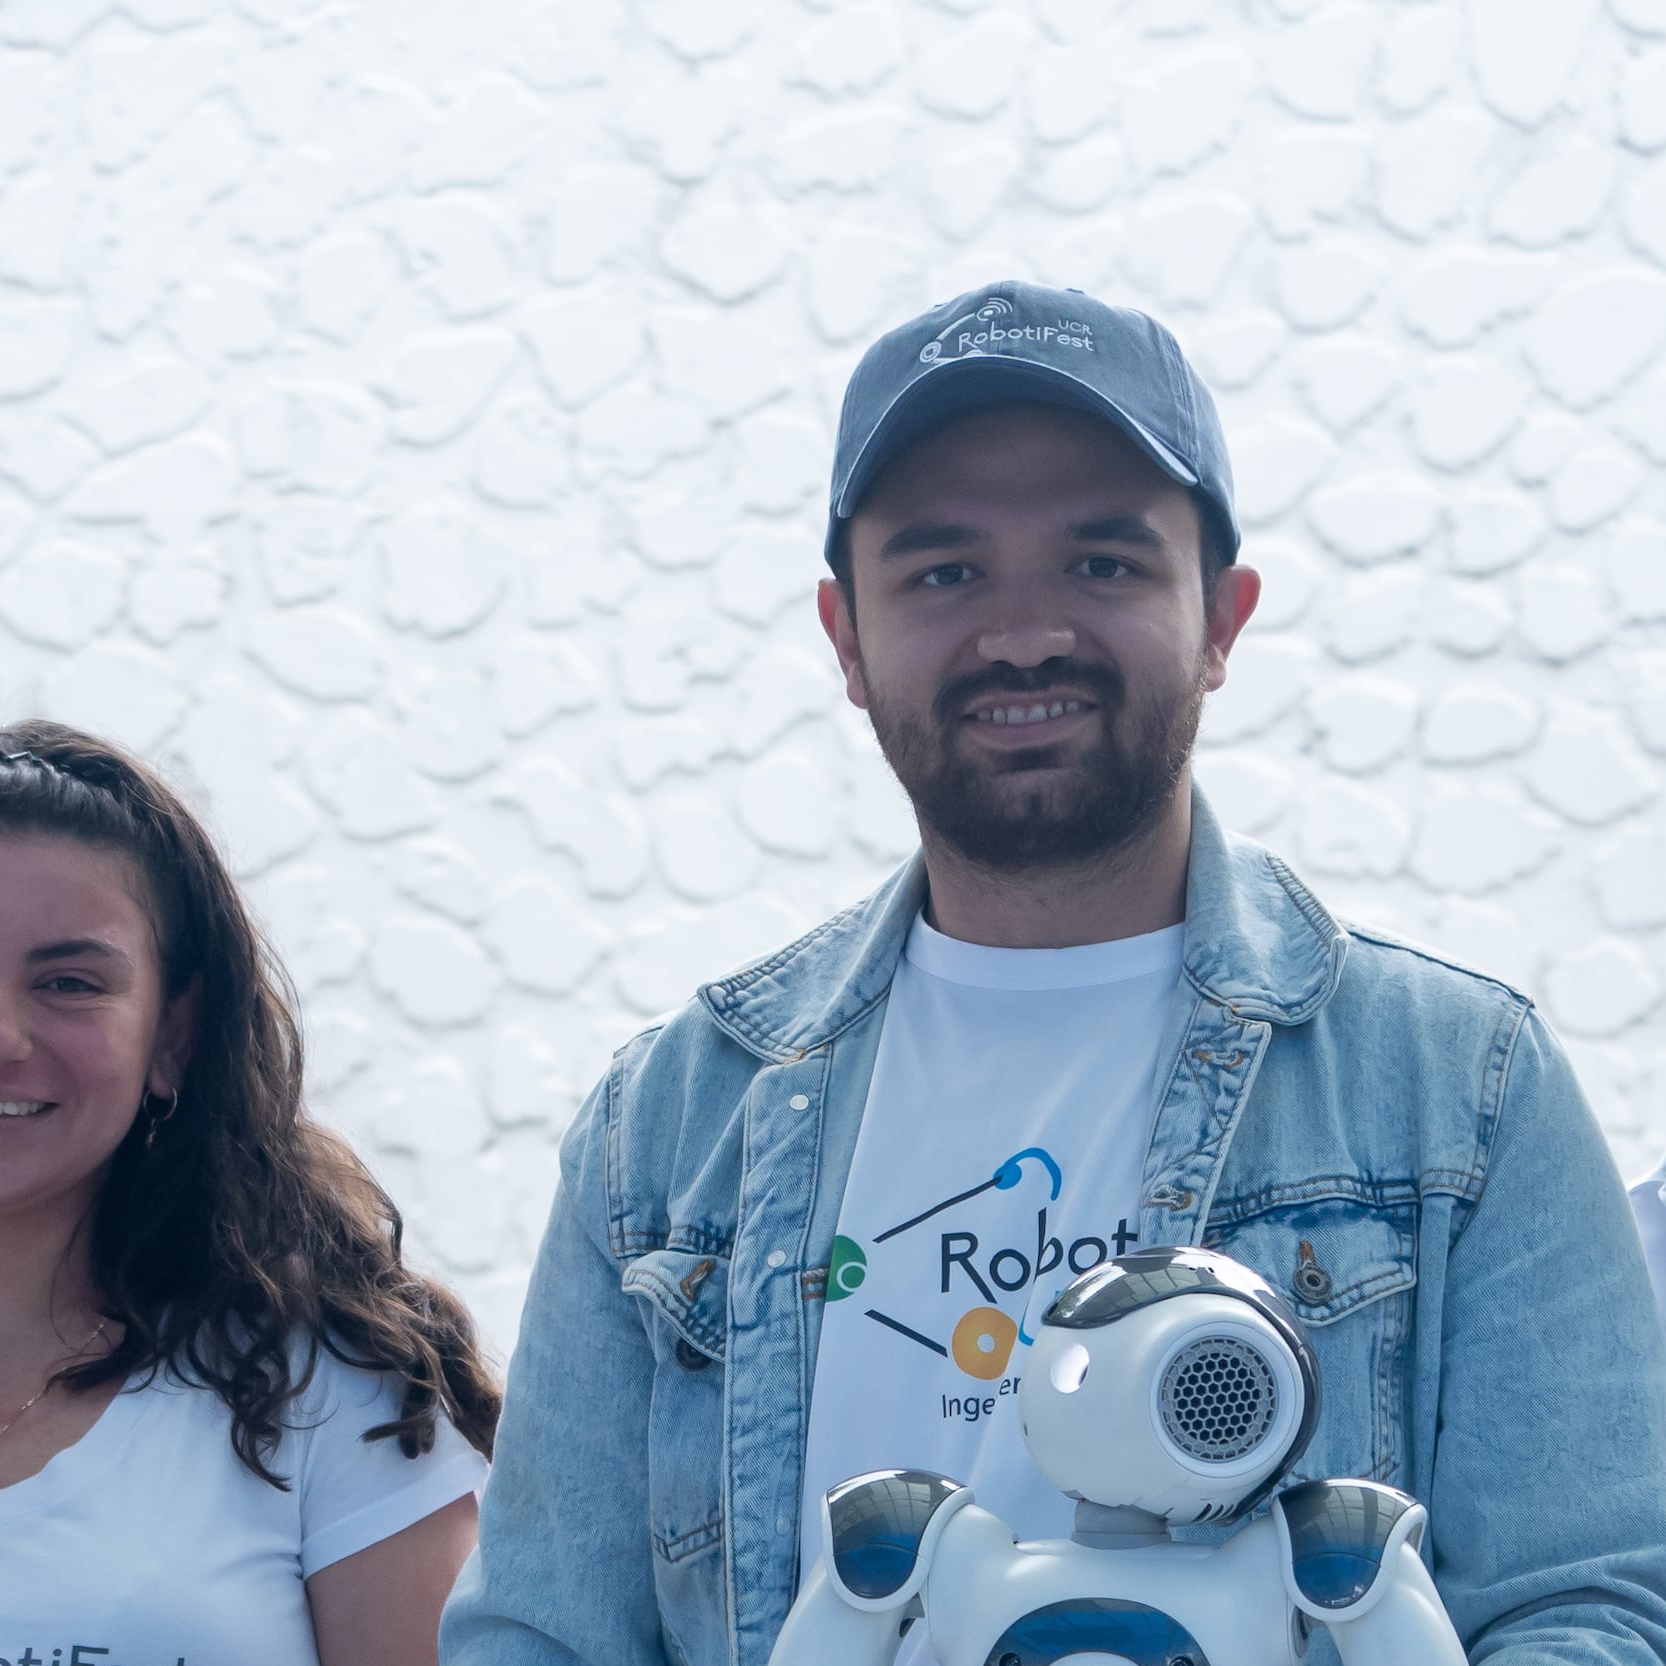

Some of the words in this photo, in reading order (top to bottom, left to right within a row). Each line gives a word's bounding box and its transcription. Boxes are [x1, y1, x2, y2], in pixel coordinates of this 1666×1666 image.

[958, 321, 1095, 353] RobotiFest
[1058, 319, 1093, 336] UCR
[941, 1207, 1138, 1304] Robot
